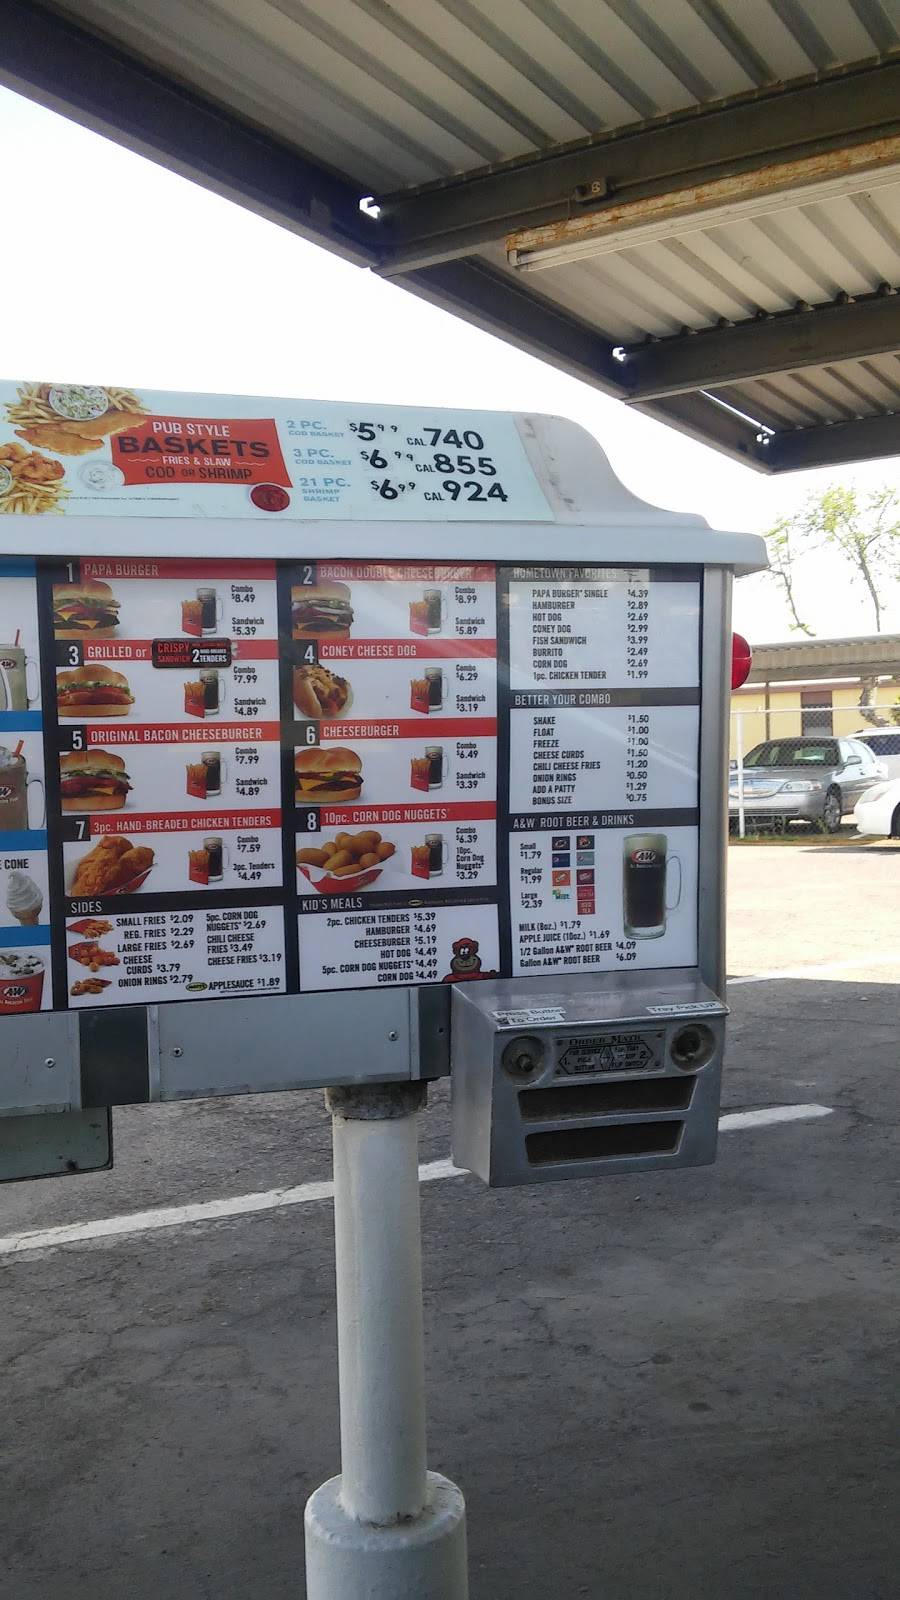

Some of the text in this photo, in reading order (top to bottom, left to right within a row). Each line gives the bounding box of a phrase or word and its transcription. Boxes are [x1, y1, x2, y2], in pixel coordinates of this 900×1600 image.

[153, 422, 230, 436] PUB STYLE
[287, 420, 326, 429] 2 PC.
[407, 428, 483, 450] CAL 740
[118, 436, 270, 457] BASKETS
[294, 448, 304, 457] 3
[162, 456, 189, 465] FRIES
[204, 458, 230, 466] SLAW
[416, 454, 497, 476] CAL 855
[145, 466, 175, 478] COD
[200, 468, 252, 479] SHRIMP
[299, 478, 351, 486] 21 PC.
[424, 480, 508, 502] CAL 924
[66, 563, 159, 582] 1 PAPA BURGER
[232, 593, 256, 603] $8.49
[233, 627, 256, 635] $5.39
[158, 642, 189, 652] CRISPY
[69, 646, 146, 665] 3 GRILLED or
[192, 649, 199, 662] 2
[304, 645, 416, 663] 4 CONEY CHEESE DOG
[234, 675, 257, 683] $7.99
[234, 698, 266, 706] Sandwich
[515, 694, 610, 705] BETTER YOUR COMBO
[235, 707, 258, 716] $4.89
[72, 728, 262, 750] 5 ORIGINAL BACON CHEESEBURGER
[306, 725, 399, 744] 6 CHEESEBURGER
[457, 750, 478, 758] $6.49
[457, 780, 478, 788] $3.39
[308, 812, 316, 830] 8
[325, 814, 350, 824] 10pc.
[353, 810, 379, 821] CORN
[382, 810, 400, 820] DOG
[513, 815, 634, 829] A&W ROOT BEER & DRINKS
[76, 816, 271, 840] 7 3pc. HAND-BREADED CHICKEN TENDERS
[237, 844, 260, 853] $7.59
[521, 851, 541, 860] $1.79
[5, 858, 29, 870] CONE
[238, 872, 261, 880] $4.49
[71, 901, 102, 913] SIDES
[302, 899, 327, 911] KID'S
[331, 898, 362, 909] MEALS
[116, 914, 193, 926] SMALL FRIES $2.09
[327, 913, 436, 926] 2pc. CHICKEN TENDERS $5.39
[519, 921, 581, 931] MILK (8oz.) $1.79
[124, 928, 194, 939] REG. FRIES $2.29
[207, 933, 254, 944] CHILI CHEESE
[520, 934, 541, 943] APPLE
[563, 932, 585, 941] (10oz.)
[589, 930, 610, 939] $1.69
[118, 940, 194, 952] LARGE FRIES $2.69
[354, 938, 410, 948] CHEESEBURGER
[207, 945, 228, 954] FRIES
[124, 955, 152, 964] CHEESE
[208, 954, 281, 966] CHEESE FRIES $3.19
[126, 964, 180, 974] CURDS $3.79
[118, 974, 193, 987] ONION RINGS $2.79
[209, 979, 254, 990] APPLESAUCE
[257, 978, 280, 986] $1.89
